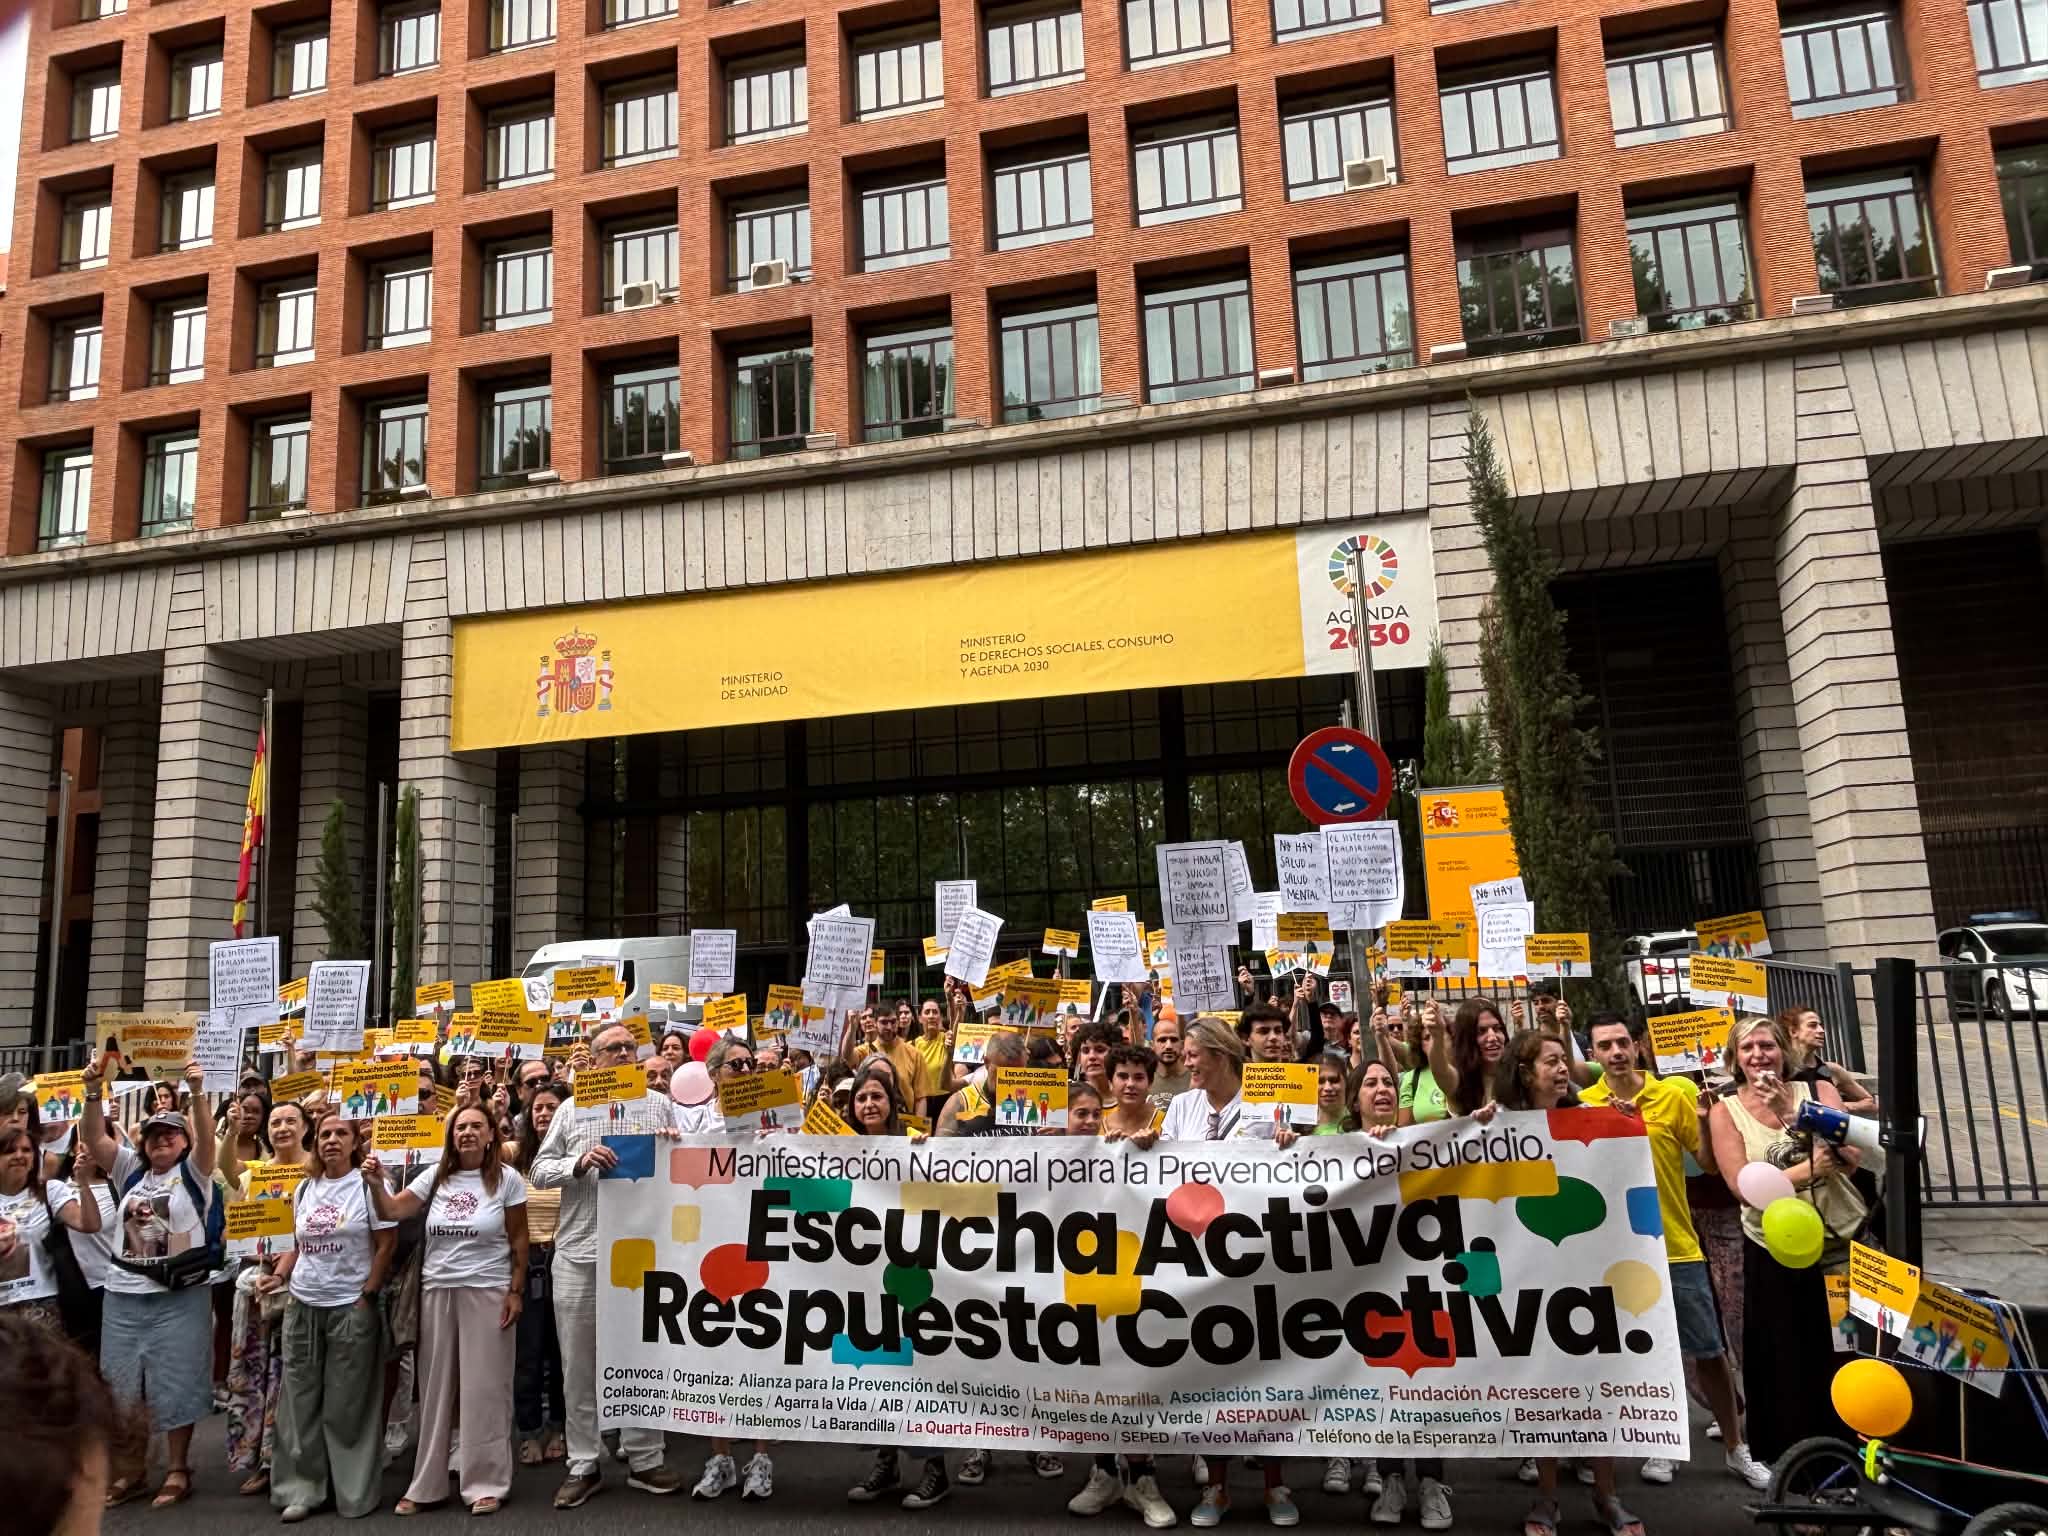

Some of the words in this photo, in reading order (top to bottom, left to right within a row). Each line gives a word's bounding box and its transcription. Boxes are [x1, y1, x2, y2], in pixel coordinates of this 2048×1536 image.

[1326, 605, 1410, 625] AGNDA
[961, 633, 1026, 648] MINISTERIO
[961, 652, 977, 663] DE
[979, 646, 1043, 662] DERECHOS
[1107, 634, 1174, 651] CONSUMO
[721, 671, 783, 686] MINISTERIO
[961, 668, 968, 679] Y
[970, 664, 1021, 677] AGENDA
[1023, 661, 1049, 673] 2030
[721, 690, 736, 701] DE
[738, 686, 788, 699] SANIDAD
[708, 1147, 901, 1182] Manifestación
[909, 1150, 1038, 1184] Nacional
[1047, 1159, 1115, 1192] para
[1124, 1153, 1148, 1185] la
[1159, 1150, 1344, 1185] Prevención
[1353, 1147, 1402, 1181] del
[1411, 1128, 1553, 1171] Suicidio.
[746, 1189, 1118, 1275] Escucha
[1134, 1186, 1496, 1279] Activa.
[642, 1271, 1100, 1366] Respuesta
[1115, 1261, 1654, 1368] Colectiva.
[603, 1367, 664, 1381] Convoca
[673, 1369, 734, 1388] Organiza:
[739, 1373, 792, 1389] Alianza
[796, 1377, 828, 1393] para
[832, 1376, 844, 1390] la
[849, 1377, 932, 1395] Prevención
[937, 1381, 958, 1396] del
[962, 1382, 1020, 1398] Suicidio
[1055, 1388, 1090, 1404] Niña
[1169, 1386, 1261, 1403] Asociación
[1266, 1386, 1304, 1402] Sara
[1308, 1384, 1384, 1403] Jiménez,
[1389, 1384, 1481, 1401] Fundación
[1486, 1384, 1580, 1401] Acrescere
[1585, 1385, 1594, 1402] y
[603, 1386, 668, 1400] Colaboran:
[671, 1389, 716, 1405] Abrazos
[719, 1393, 763, 1407] Verdes
[774, 1396, 818, 1412] Agarra
[822, 1397, 832, 1410] la
[837, 1397, 867, 1411] Vida
[879, 1399, 904, 1412] AIB
[915, 1400, 968, 1414] AIDATU
[1031, 1406, 1087, 1424] Ángeles
[1090, 1410, 1108, 1423] de
[1111, 1411, 1143, 1426] Azul
[1147, 1414, 1156, 1428] y
[1159, 1410, 1203, 1426] Verde
[1215, 1409, 1310, 1424] ASEPADUAL
[1323, 1408, 1377, 1423] ASPAS
[1389, 1407, 1502, 1426] Atrapasueños
[1515, 1407, 1602, 1422] Besarkada
[1619, 1405, 1678, 1422] Abrazo
[603, 1404, 666, 1418] CEPSICAP
[673, 1408, 726, 1425] FELGTBI+
[735, 1414, 801, 1429] Hablemos
[812, 1418, 827, 1430] La
[830, 1417, 895, 1433] Barandilla
[907, 1420, 922, 1433] La
[926, 1420, 972, 1436] Quarta
[975, 1422, 1030, 1438] Finestra
[1040, 1426, 1110, 1443] Papageno
[1120, 1431, 1170, 1445] SEPED
[1181, 1431, 1199, 1444] Te
[1203, 1431, 1231, 1444] Veo
[1234, 1429, 1294, 1443] Mañana
[1308, 1428, 1372, 1443] Teléfono
[1375, 1430, 1393, 1444] de
[1396, 1430, 1410, 1444] la
[1414, 1431, 1497, 1448] Esperanza
[1509, 1429, 1608, 1445] Tramuntana
[1620, 1427, 1681, 1445] Ubuntu
